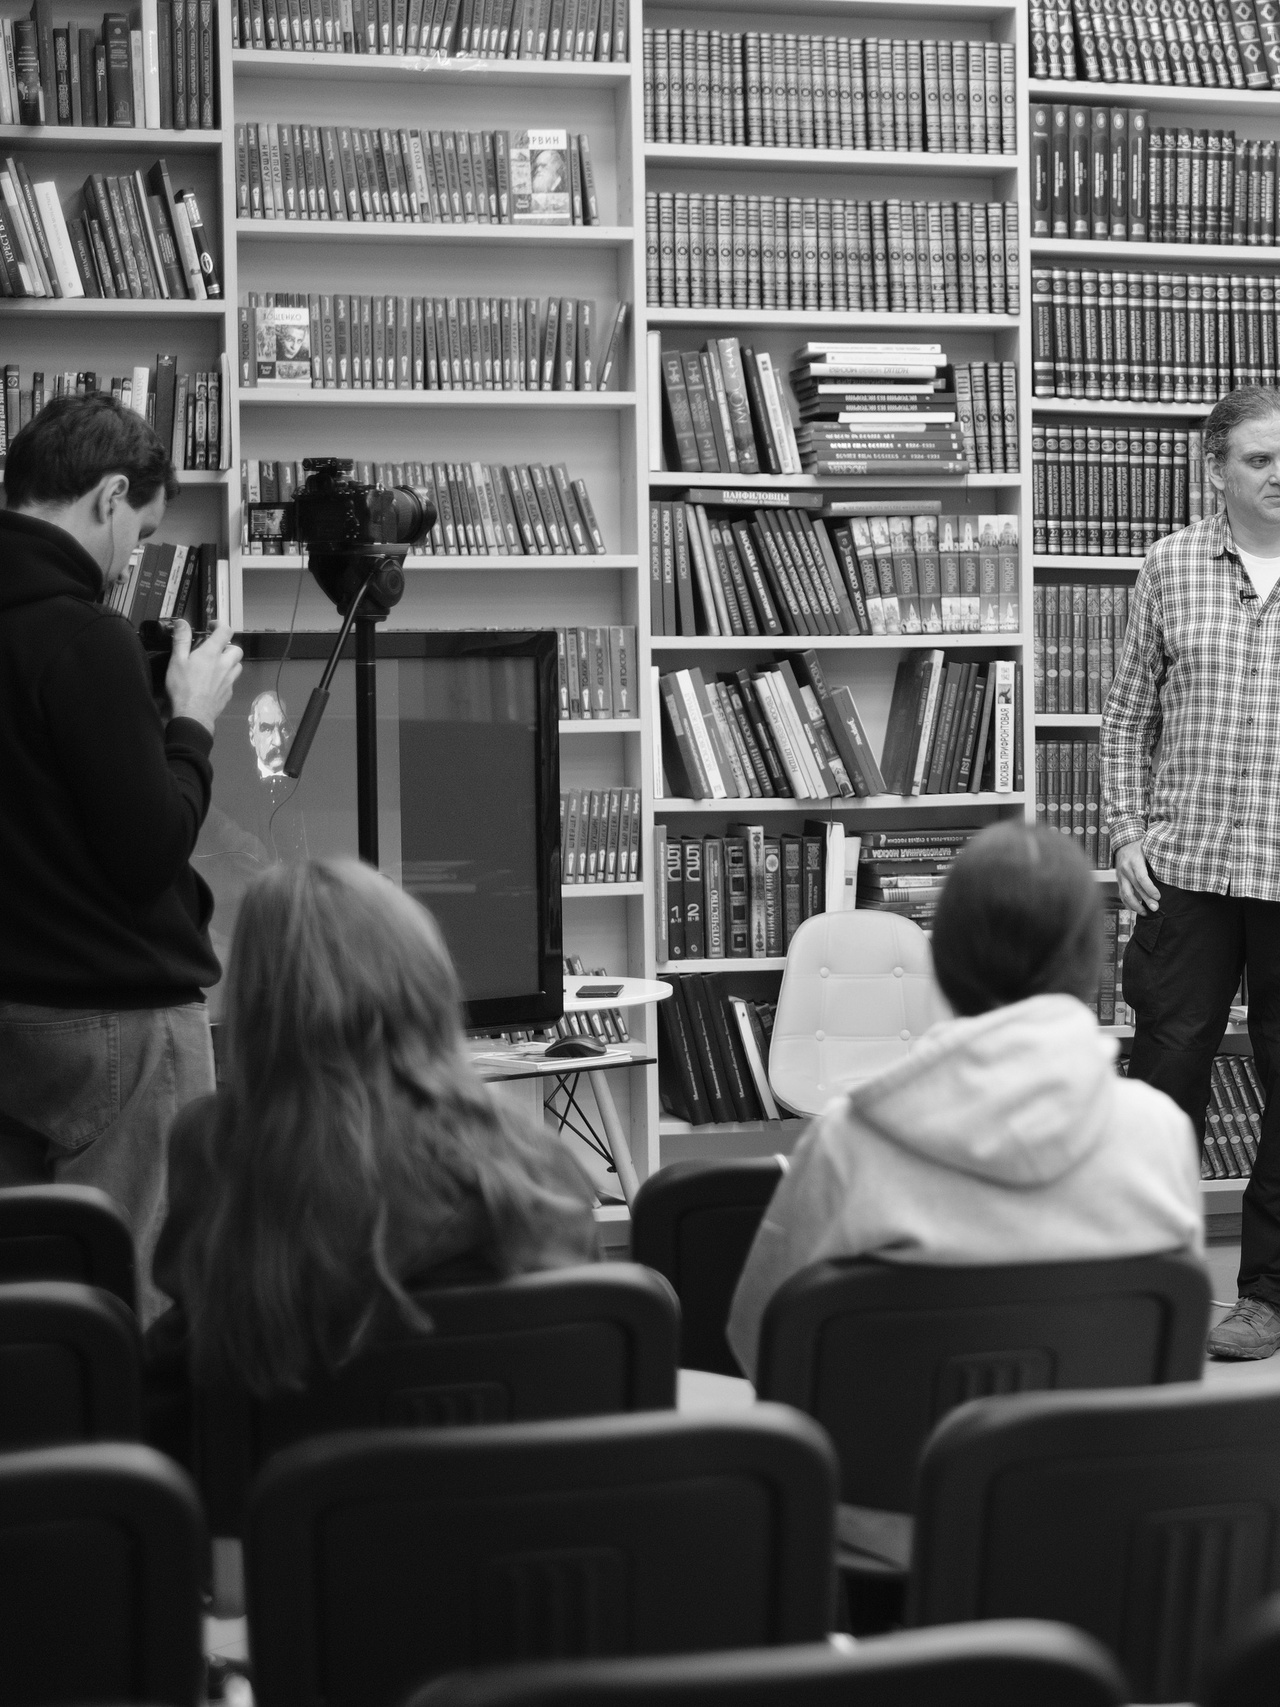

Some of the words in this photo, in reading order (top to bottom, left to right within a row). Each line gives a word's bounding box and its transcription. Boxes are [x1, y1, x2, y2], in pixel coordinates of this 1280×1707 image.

[262, 144, 270, 181] ГАРШИН
[272, 145, 280, 182] ГАРШИН
[413, 142, 423, 170] ГЮГО
[461, 158, 471, 187] ДАЛЬ
[475, 159, 484, 188] ДАЛЬ
[1, 233, 15, 263] КРЕСТ
[77, 239, 92, 279] МОНАСТЫРИ
[324, 318, 332, 355] КИРОВ
[723, 346, 748, 424] МОСКВА
[1090, 372, 1095, 380] 3
[1120, 373, 1125, 381] 5
[1134, 374, 1140, 382] 6
[1149, 374, 1154, 382] 7
[1164, 375, 1170, 383] 8
[1178, 375, 1184, 383] 8
[1207, 376, 1213, 384] 9
[1221, 377, 1229, 385] 10
[703, 439, 711, 449] 2
[723, 491, 790, 501] ПАНФИЛОВЦЫ
[676, 508, 684, 542] МОСКВЫ
[1035, 528, 1045, 536] 21
[1050, 529, 1059, 537] 22
[1062, 529, 1072, 537] 23
[1076, 529, 1085, 537] 24
[1089, 529, 1099, 537] 25
[1133, 531, 1142, 539] 29
[1145, 531, 1155, 539] 30
[739, 530, 756, 567] МОСКВА
[652, 546, 660, 581] ИСТОРИЯ
[679, 545, 687, 580] ИСТОРИЯ
[845, 555, 860, 589] СОРОКОВ
[869, 564, 877, 588] СОРОК
[862, 560, 873, 594] СОРОКОВ
[880, 559, 889, 594] СОРОКОВ
[901, 559, 909, 594] СОРОКОВ
[853, 591, 866, 617] СОРОК
[594, 647, 603, 676] ТОЛСТОЙ
[617, 648, 627, 677] ТОЛСТОЙ
[809, 661, 828, 699] МОСКВА
[765, 695, 780, 724] МОСКВА
[739, 713, 756, 747] МОСКВЫ
[999, 707, 1010, 760] ПРИФРОНТОВАЯ
[965, 734, 973, 757] МОСКВА
[784, 747, 798, 773] НАША
[999, 760, 1010, 787] МОСКВА
[671, 905, 679, 918] 1
[687, 903, 700, 917] 2
[711, 889, 720, 946] ОТЕЧЕСТВО
